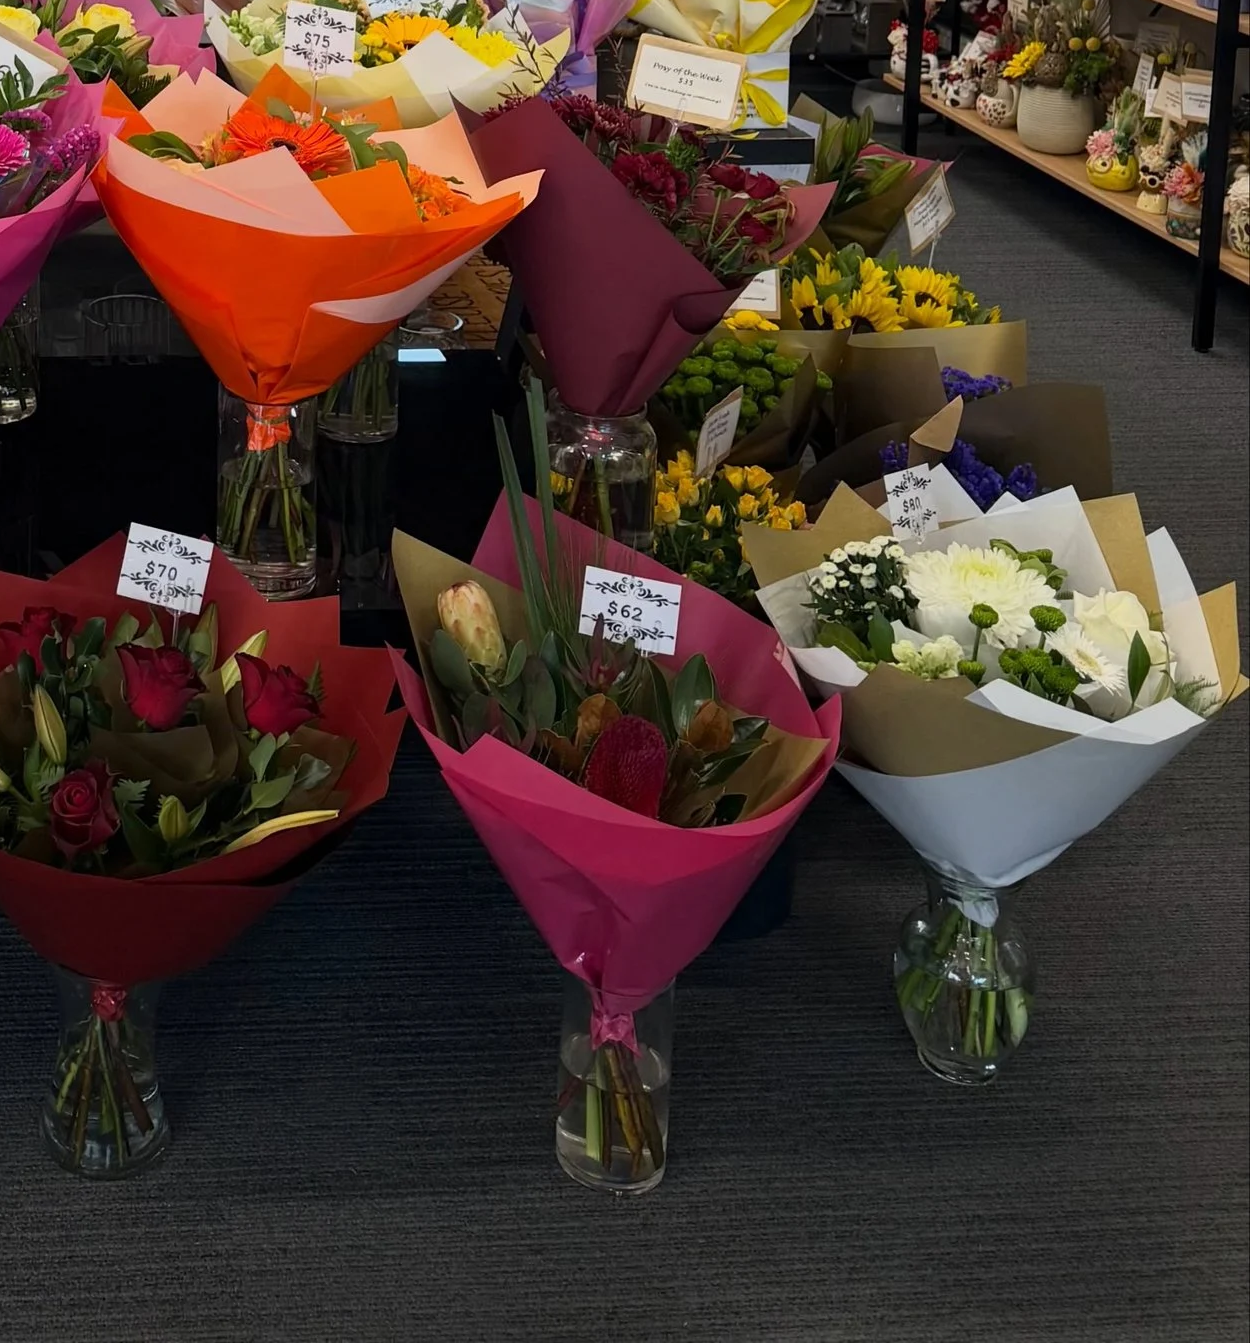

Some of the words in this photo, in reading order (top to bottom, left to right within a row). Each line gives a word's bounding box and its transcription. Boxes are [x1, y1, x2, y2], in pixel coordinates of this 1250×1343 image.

[303, 32, 331, 49] $75
[653, 61, 672, 73] Posy
[673, 67, 683, 76] of
[683, 68, 698, 77] the
[699, 72, 722, 83] Week
[678, 77, 694, 87] $35
[902, 495, 923, 513] $80
[144, 559, 179, 582] $70
[608, 599, 643, 623] $62
